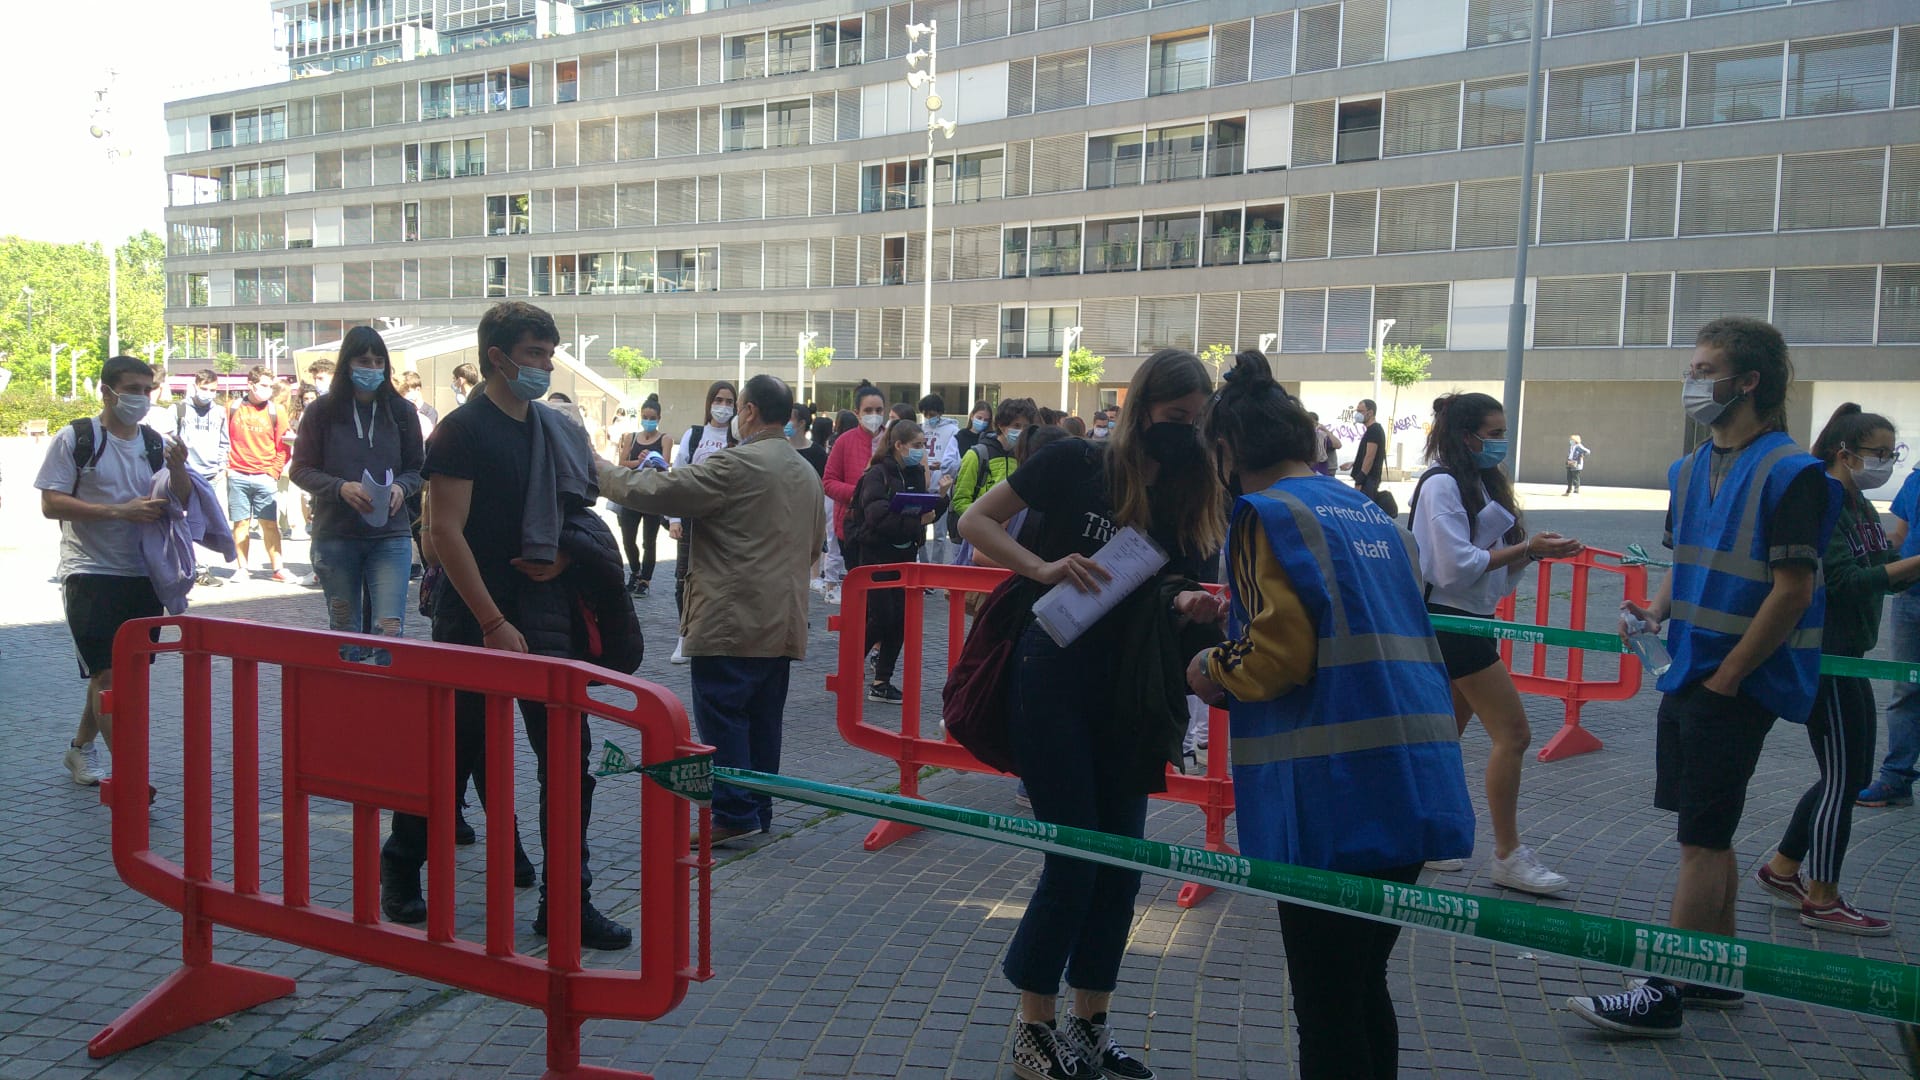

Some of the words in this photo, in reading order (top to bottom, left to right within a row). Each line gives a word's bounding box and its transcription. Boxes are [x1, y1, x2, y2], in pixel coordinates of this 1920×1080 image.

[1315, 504, 1366, 523] evento
[1352, 538, 1392, 560] staff
[1652, 931, 1748, 968] GASTEIZ
